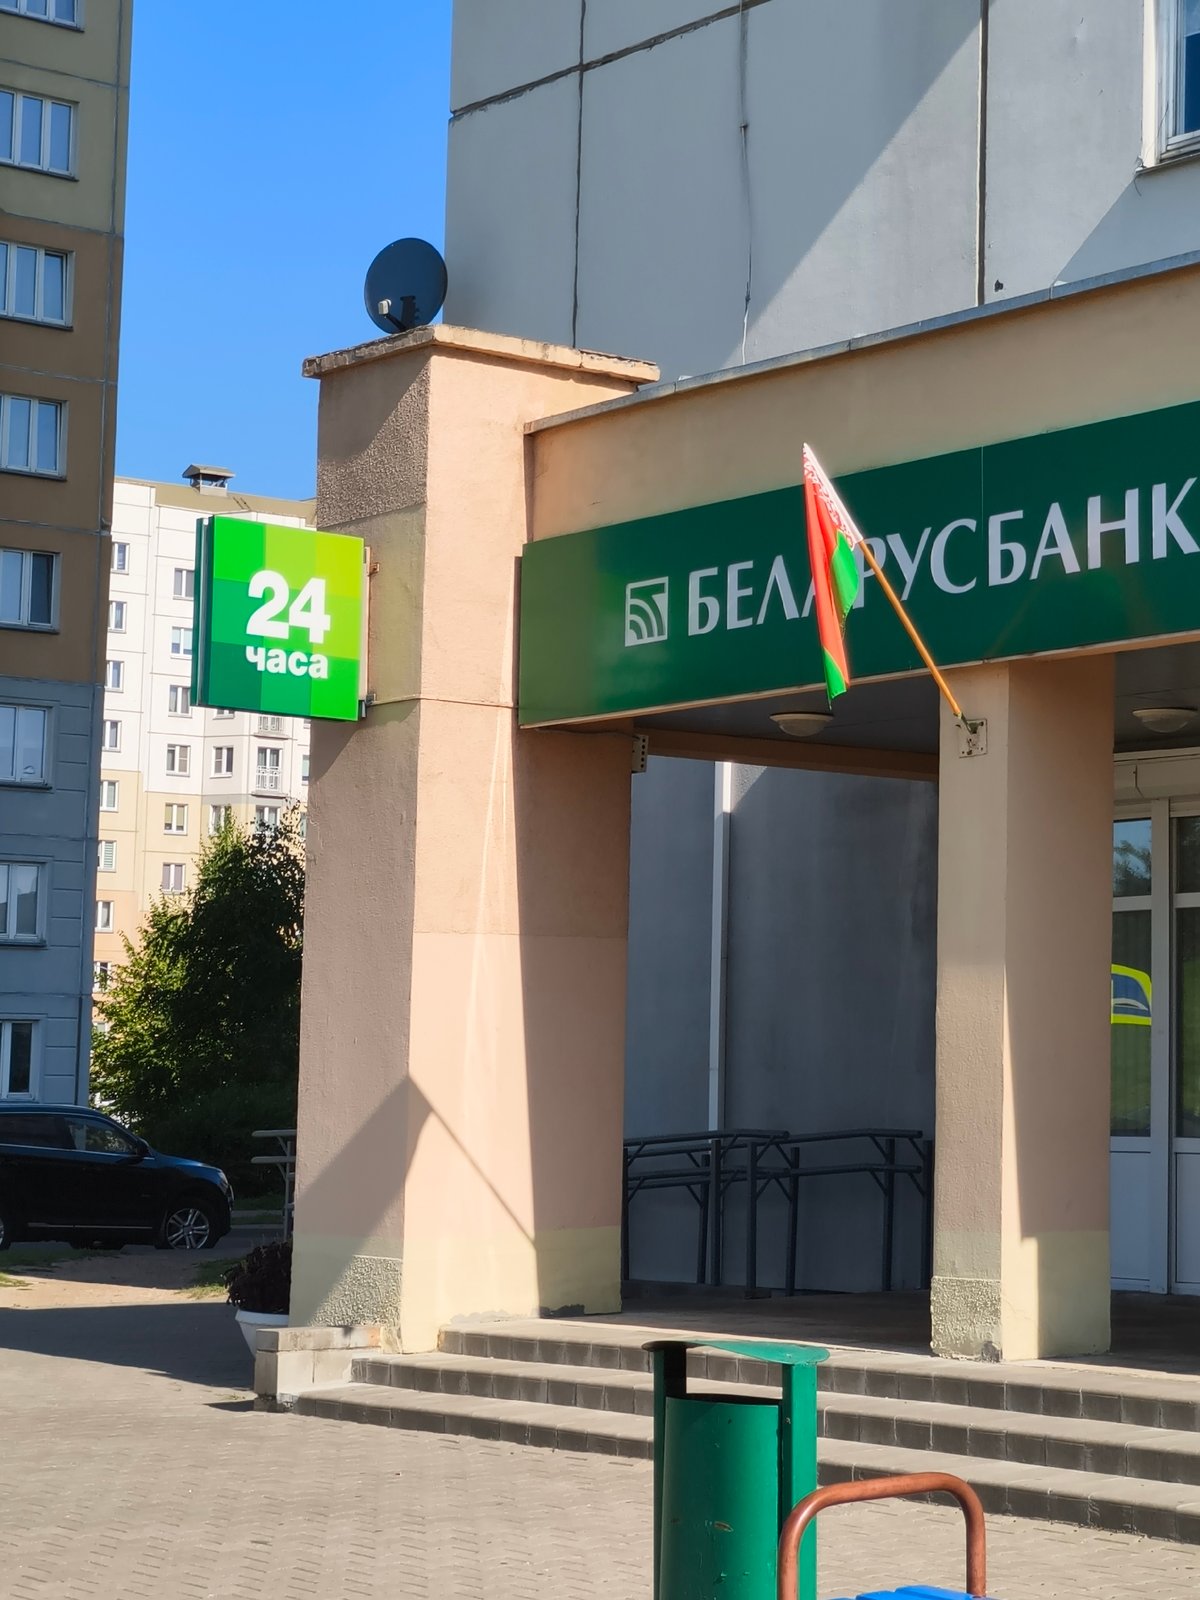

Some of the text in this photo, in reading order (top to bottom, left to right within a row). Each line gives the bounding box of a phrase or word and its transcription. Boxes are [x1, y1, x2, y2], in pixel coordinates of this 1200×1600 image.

[687, 477, 1200, 636] БЕЛРУСБАНК
[246, 570, 331, 644] 24
[246, 645, 329, 680] часа
